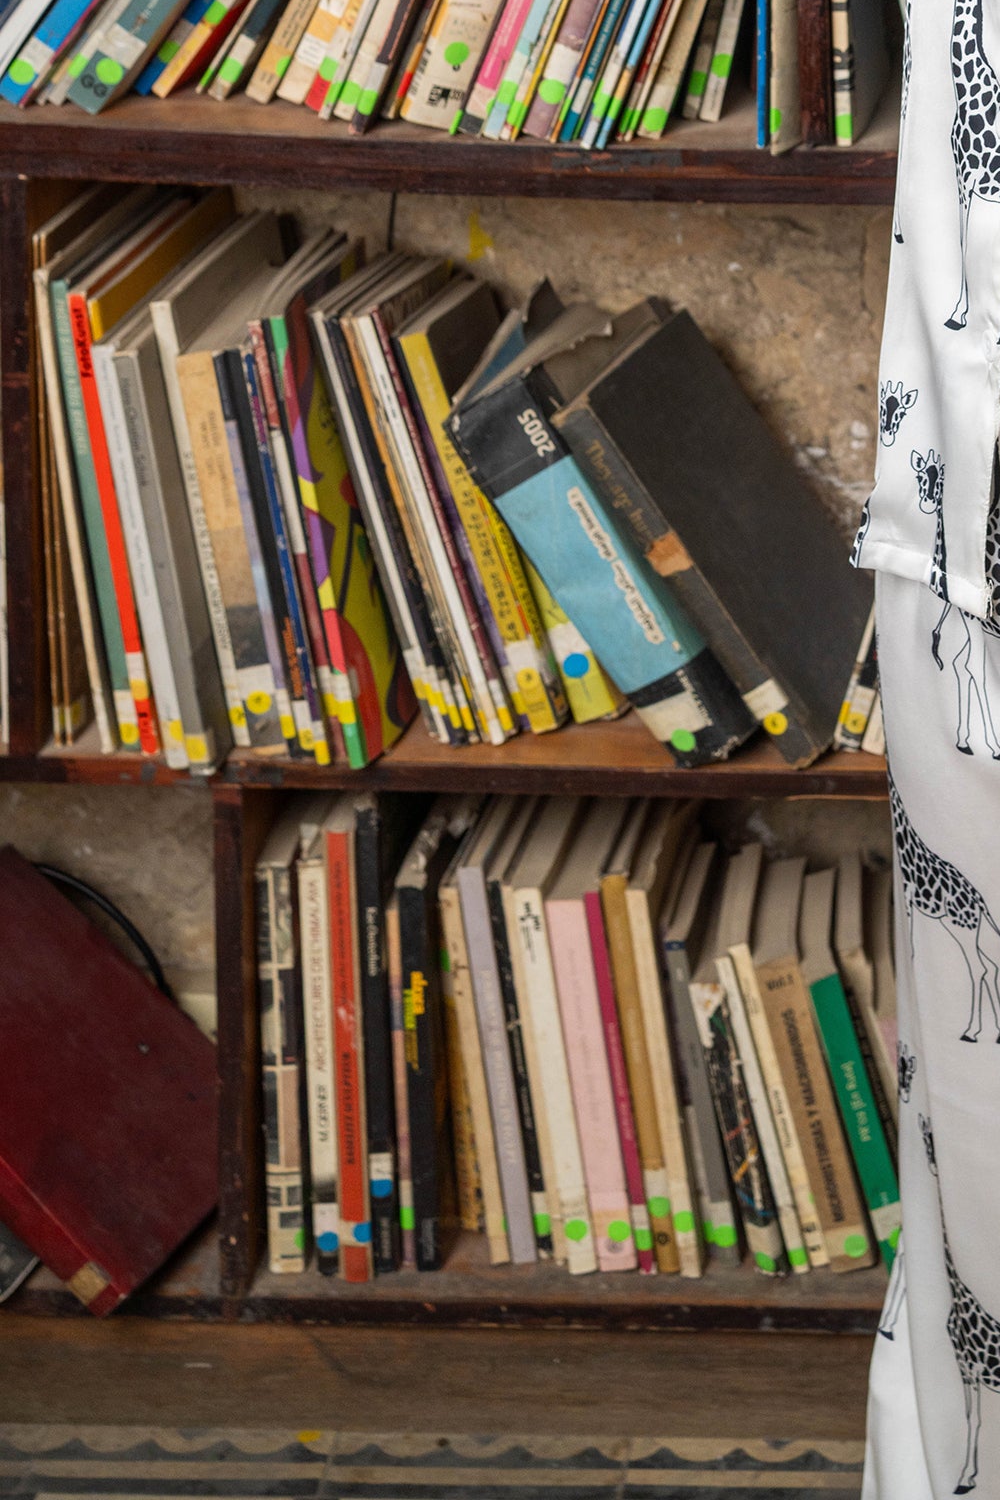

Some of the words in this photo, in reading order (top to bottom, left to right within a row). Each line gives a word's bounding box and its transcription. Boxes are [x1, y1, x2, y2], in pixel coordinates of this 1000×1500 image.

[72, 307, 92, 378] FotoKunst
[516, 407, 556, 459] 2005
[179, 449, 201, 498] AIRES
[448, 465, 468, 484] la
[456, 488, 478, 510] de
[190, 507, 216, 571] BUENOS
[483, 570, 513, 618] Trame
[497, 620, 522, 646] La
[306, 878, 322, 955] L'HIMALAYA
[310, 957, 322, 971] DE
[310, 975, 327, 1072] ARCHITECTURES
[780, 1007, 817, 1107] MACROMUNDOS
[808, 1117, 847, 1223] MICROHISTORIAS
